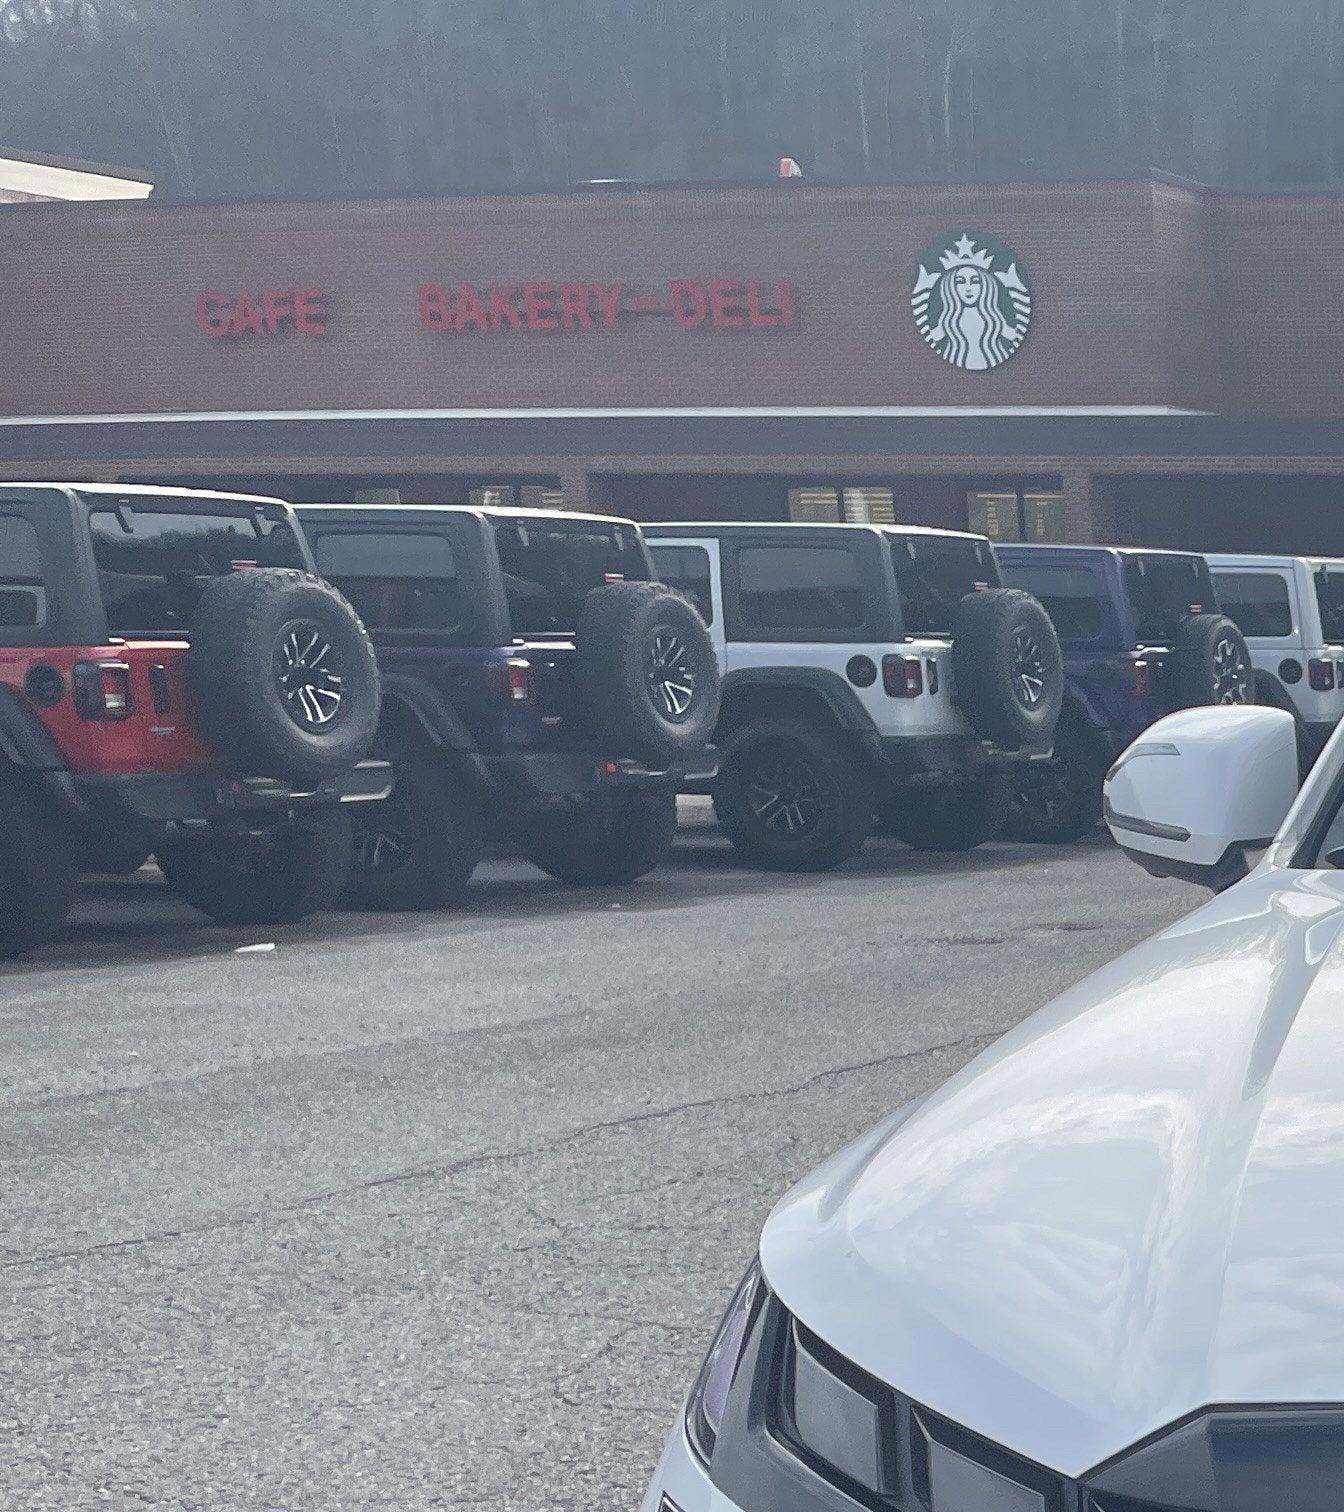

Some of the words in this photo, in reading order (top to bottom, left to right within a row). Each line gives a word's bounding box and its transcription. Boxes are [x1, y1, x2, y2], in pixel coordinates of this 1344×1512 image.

[195, 286, 325, 338] CAFE
[417, 281, 624, 331] BAKERY
[669, 278, 794, 328] DELI
